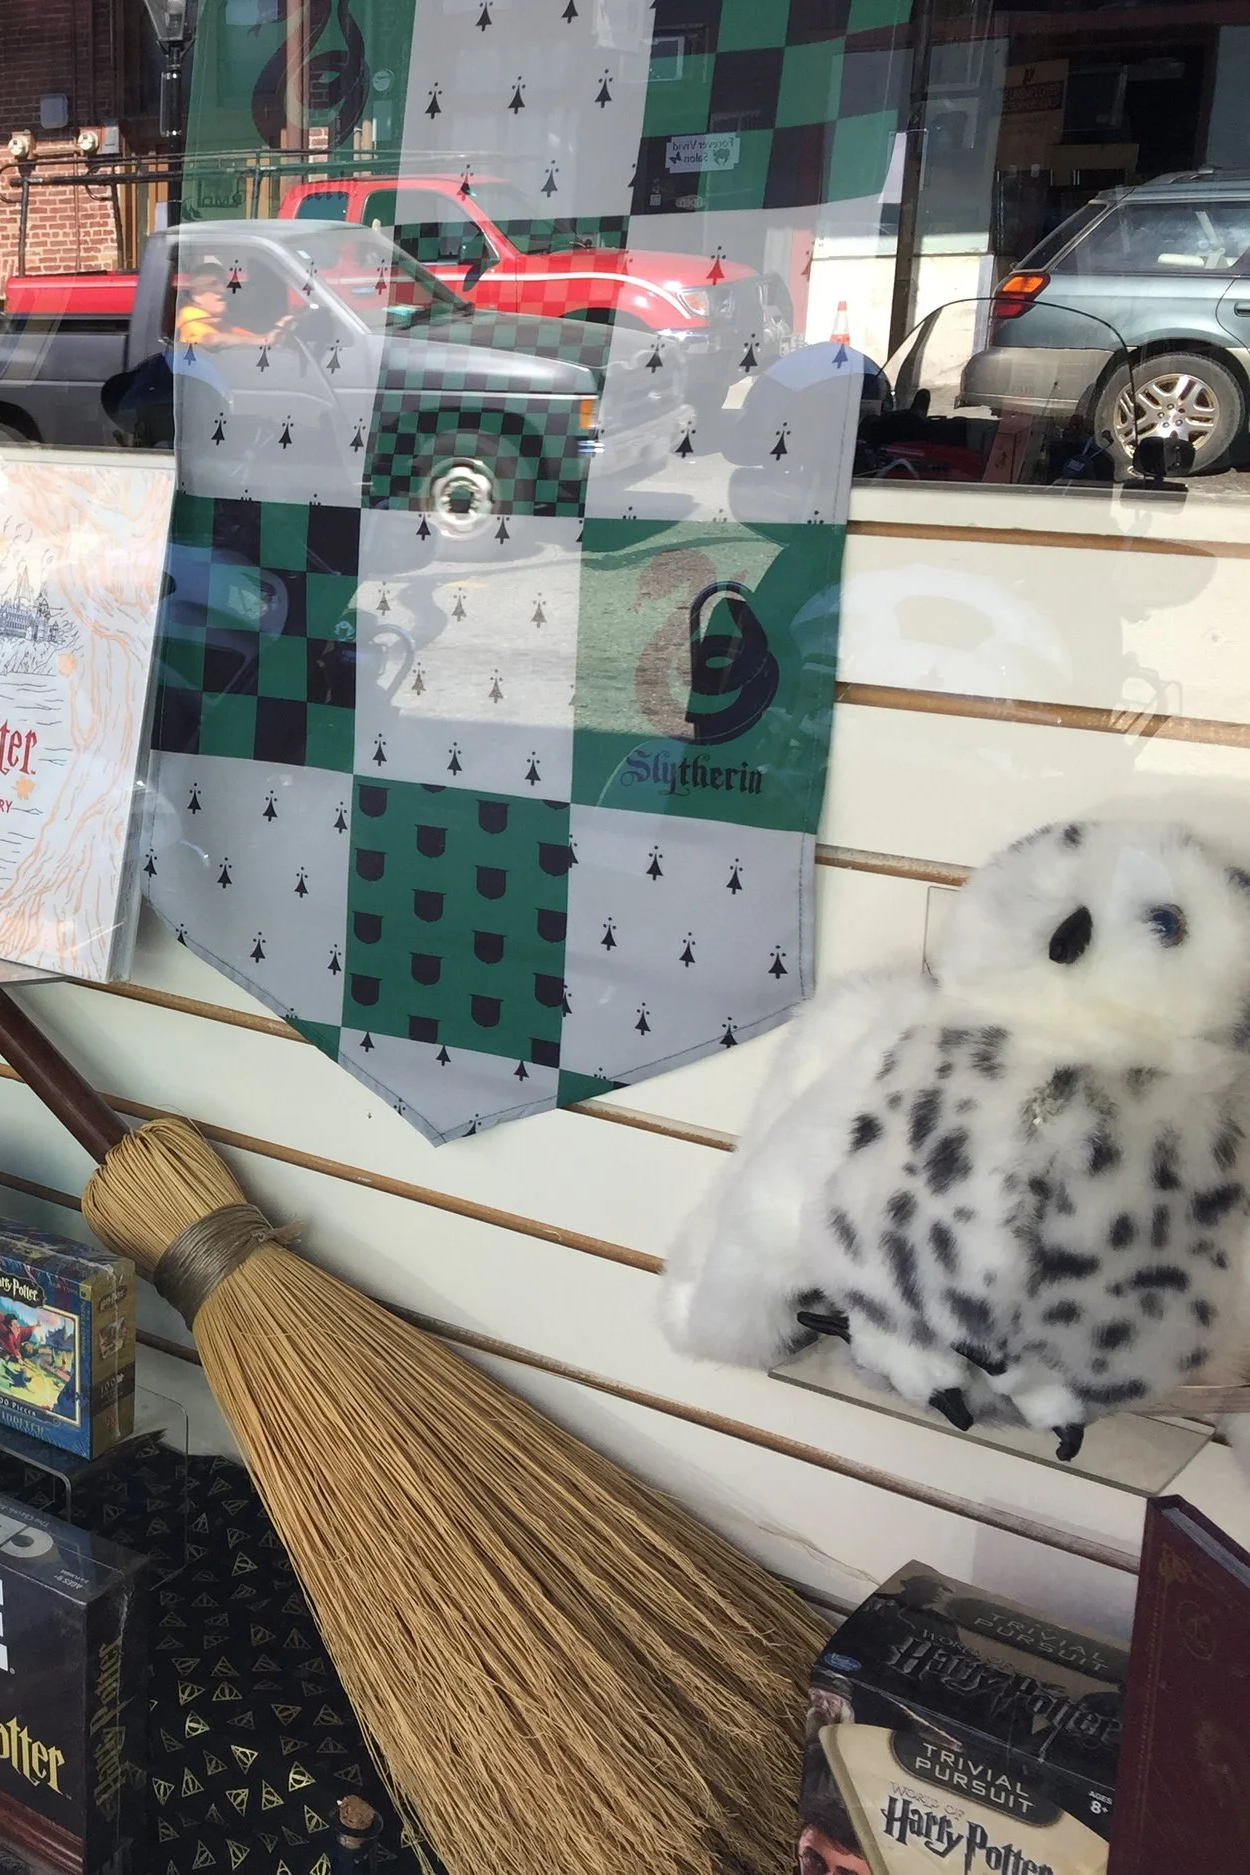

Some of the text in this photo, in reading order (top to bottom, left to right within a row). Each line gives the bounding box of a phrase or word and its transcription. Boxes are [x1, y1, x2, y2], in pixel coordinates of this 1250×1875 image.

[620, 750, 764, 797] Slytherin
[12, 1280, 39, 1302] Potter
[973, 1616, 1108, 1673] PURSUIT
[991, 1613, 1105, 1660] TRIVIAL
[883, 1636, 1122, 1749] Harry Potter
[915, 1757, 1036, 1814] PURSUIT
[923, 1742, 1030, 1798] TRIVIAL
[1089, 1790, 1112, 1805] AGES
[1090, 1801, 1109, 1814] 8+
[880, 1795, 964, 1858] Harry
